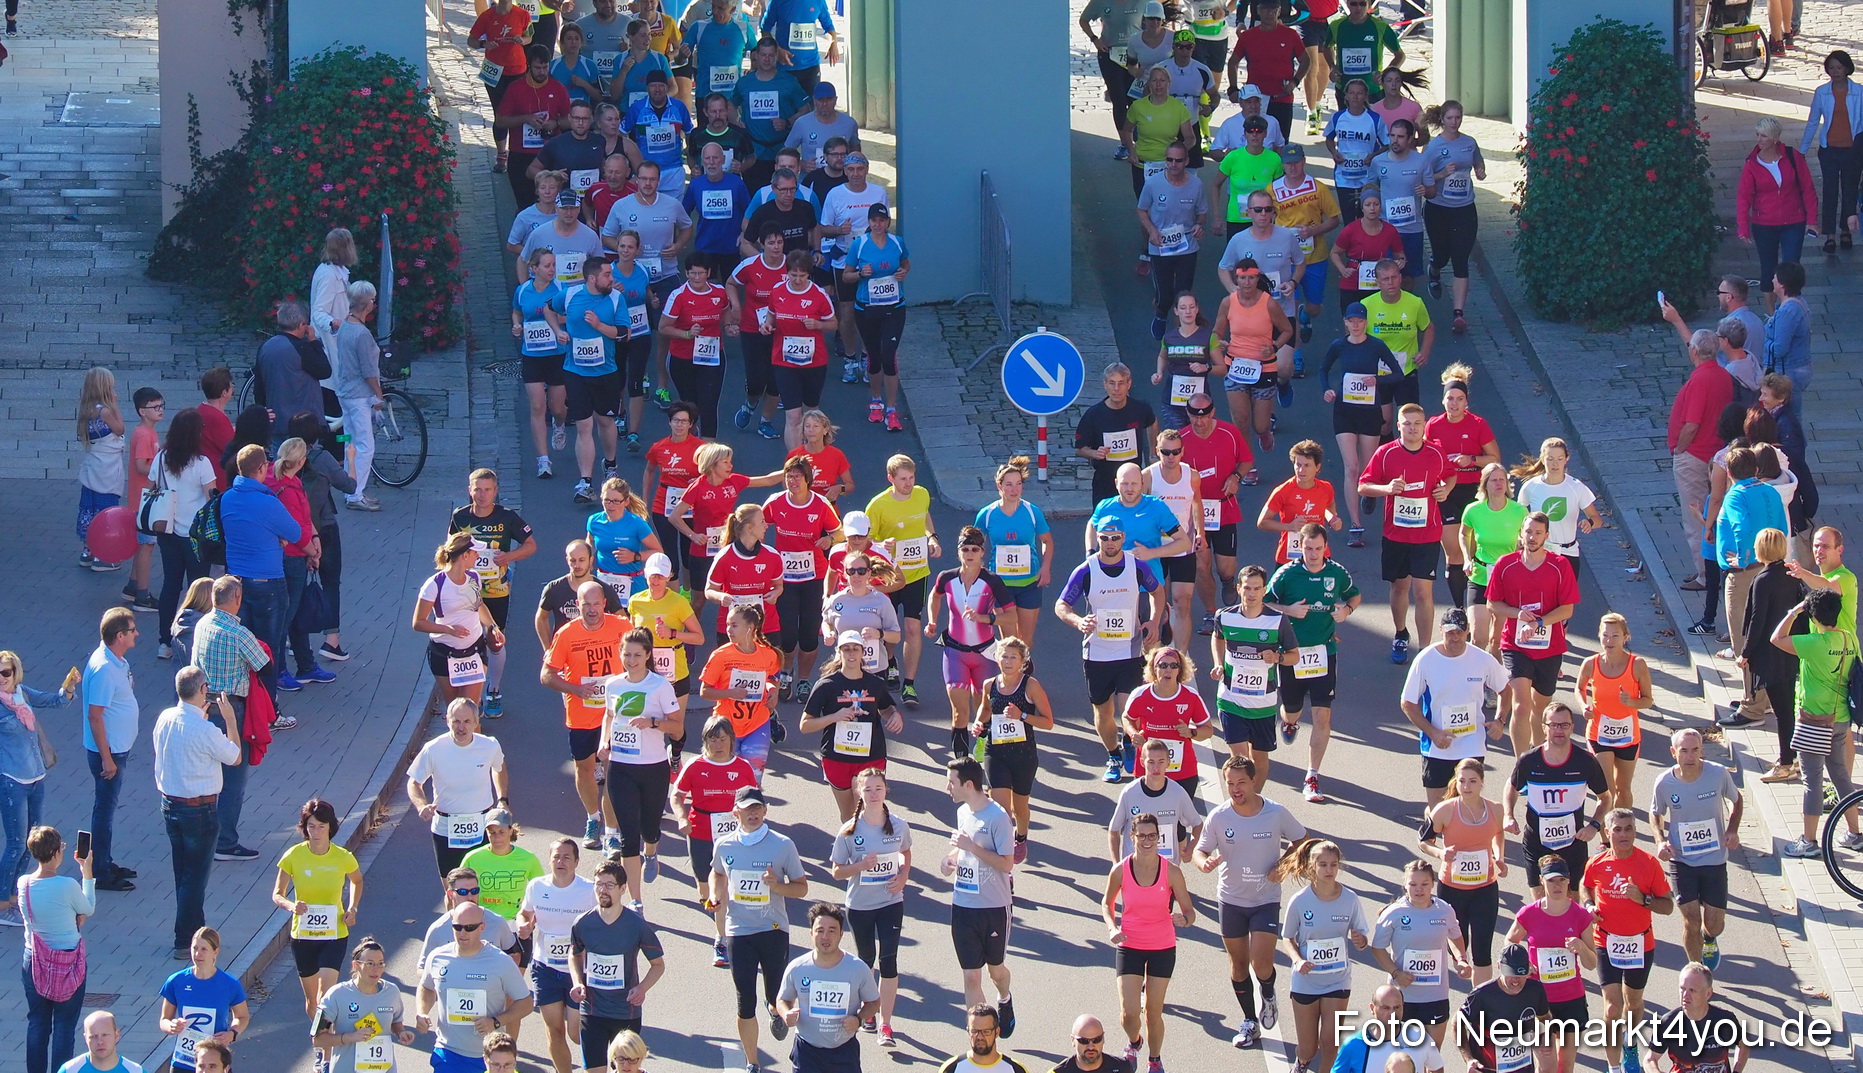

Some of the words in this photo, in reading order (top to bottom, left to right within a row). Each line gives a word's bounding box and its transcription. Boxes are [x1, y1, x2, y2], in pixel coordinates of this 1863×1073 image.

[793, 30, 812, 38] 3116
[597, 59, 614, 67] 249
[1346, 55, 1366, 63] 2567
[714, 73, 734, 81] 2076
[754, 99, 774, 107] 2102
[650, 133, 671, 143] 3099
[1344, 159, 1364, 168] 2053
[580, 177, 591, 187] 50
[1449, 179, 1467, 188] 2033
[706, 198, 728, 207] 2568
[1279, 200, 1296, 211] MAX
[1298, 194, 1319, 206] BÖGL
[1390, 205, 1412, 215] 2496
[1162, 233, 1182, 244] 2489
[566, 263, 578, 272] 47
[1366, 269, 1377, 279] 26
[873, 284, 895, 294] 2086
[528, 329, 551, 339] 2085
[577, 346, 600, 356] 2084
[698, 343, 716, 355] 2311
[787, 344, 810, 354] 2243
[1234, 366, 1256, 376] 2097
[1179, 384, 1196, 394] 287
[1350, 381, 1368, 391] 306
[1112, 439, 1129, 450] 337
[1204, 508, 1215, 518] 34
[1399, 504, 1422, 515] 2447
[482, 523, 504, 534] 2018
[903, 547, 921, 557] 293
[1006, 554, 1019, 563] 81
[786, 560, 810, 570] 2210
[1106, 618, 1123, 629] 192
[587, 646, 613, 662] RUN
[1301, 653, 1319, 665] 172
[453, 659, 478, 674] 3006
[1237, 674, 1262, 686] 2120
[733, 701, 756, 719] SY
[1450, 713, 1469, 724] 234
[998, 723, 1016, 734] 196
[1603, 725, 1629, 736] 2576
[613, 732, 636, 743] 2253
[846, 731, 861, 742] 97
[453, 822, 478, 835] 2593
[1545, 824, 1570, 837] 2061
[1684, 830, 1711, 843] 2464
[1460, 860, 1481, 872] 203
[739, 880, 760, 891] 277
[740, 895, 762, 903] Wolfgang
[307, 915, 328, 926] 292
[550, 944, 570, 955] 237
[1312, 948, 1339, 960] 2067
[1612, 943, 1639, 955] 2242
[1408, 960, 1436, 971] 2069
[1547, 957, 1568, 968] 145
[592, 964, 618, 975] 2327
[814, 991, 843, 1004] 3127
[459, 999, 474, 1011] 20
[369, 1047, 383, 1058] 19
[1501, 1045, 1528, 1059] 2060
